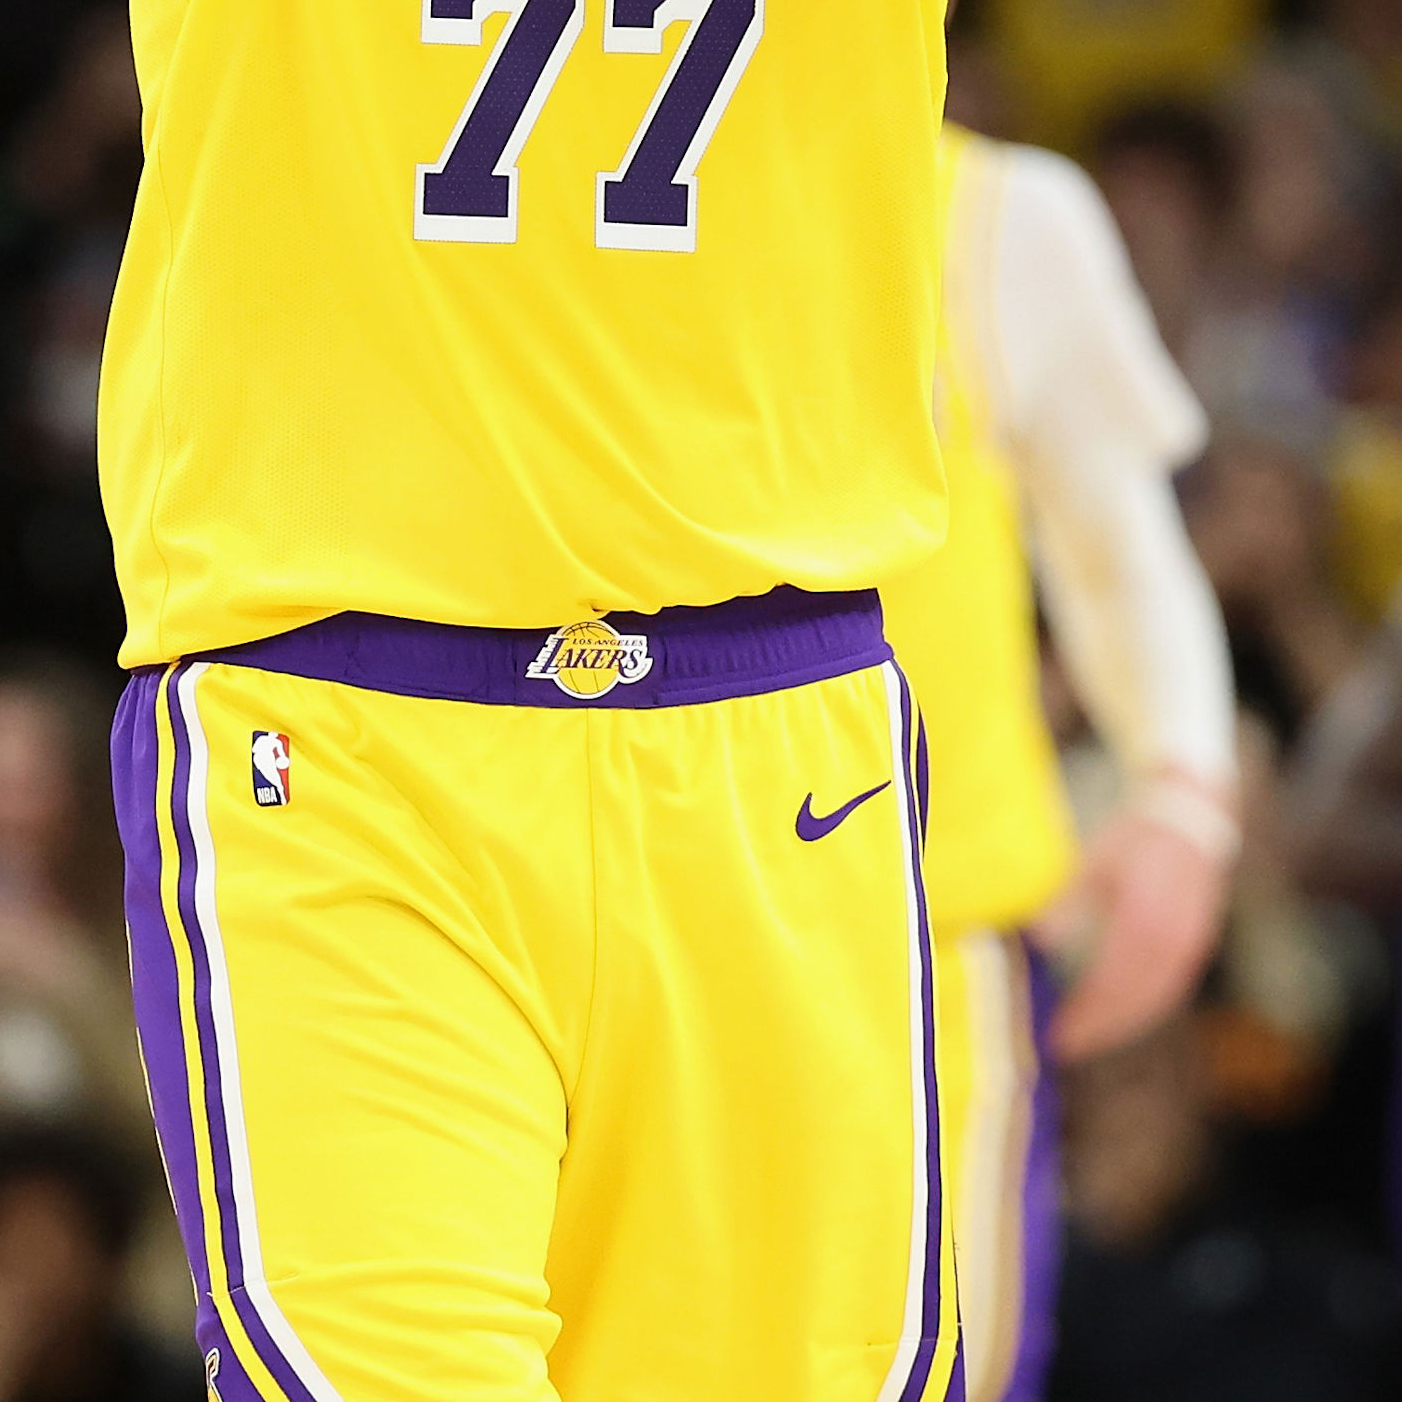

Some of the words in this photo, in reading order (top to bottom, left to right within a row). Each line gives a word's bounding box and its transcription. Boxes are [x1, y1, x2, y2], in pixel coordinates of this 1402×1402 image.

[572, 638, 593, 646] LOS
[594, 637, 644, 647] ANGELES
[538, 637, 650, 680] LAKERS
[256, 786, 278, 804] NBA
